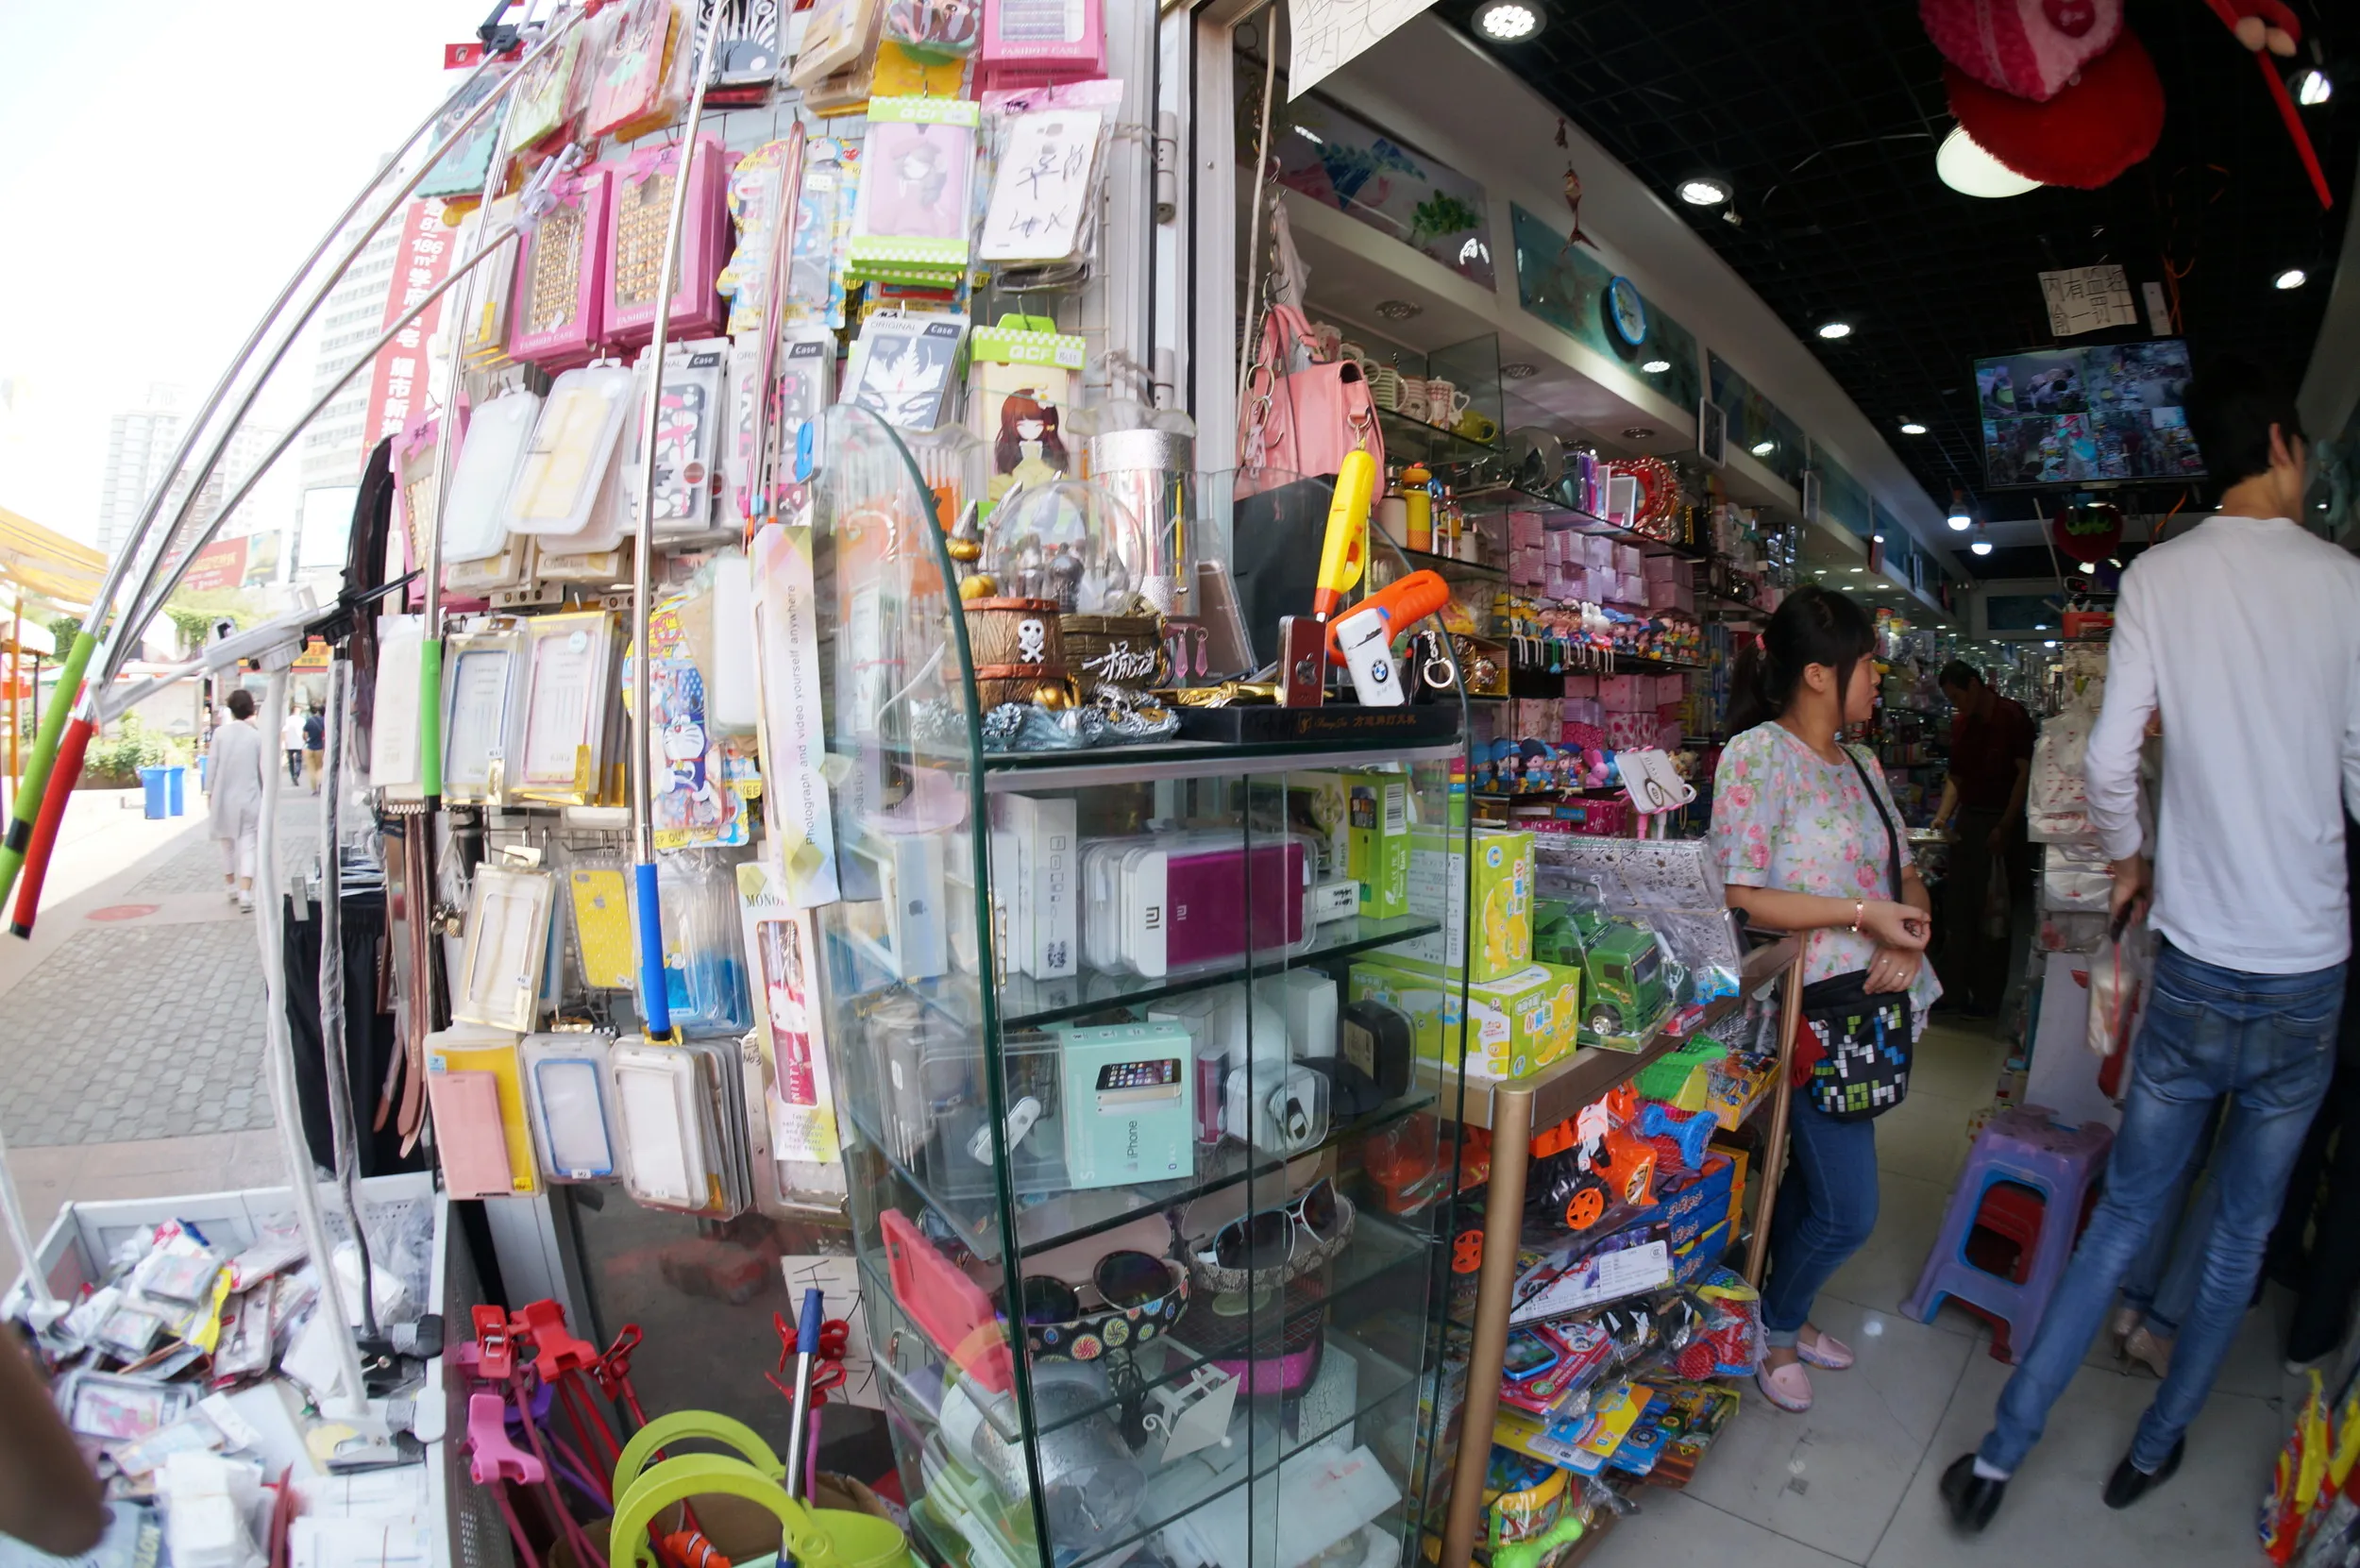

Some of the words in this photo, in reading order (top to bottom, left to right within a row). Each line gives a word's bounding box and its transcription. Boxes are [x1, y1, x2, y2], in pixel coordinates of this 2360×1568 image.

[1051, 46, 1081, 55] CASE
[870, 321, 916, 331] ORIGINAL
[930, 325, 953, 335] Case
[795, 344, 817, 355] Case
[693, 356, 714, 366] Case
[786, 584, 799, 644] anywhere
[790, 649, 804, 700] yourself
[799, 743, 807, 767] and
[800, 772, 817, 847] Photograph
[1126, 1121, 1138, 1159] iPhone
